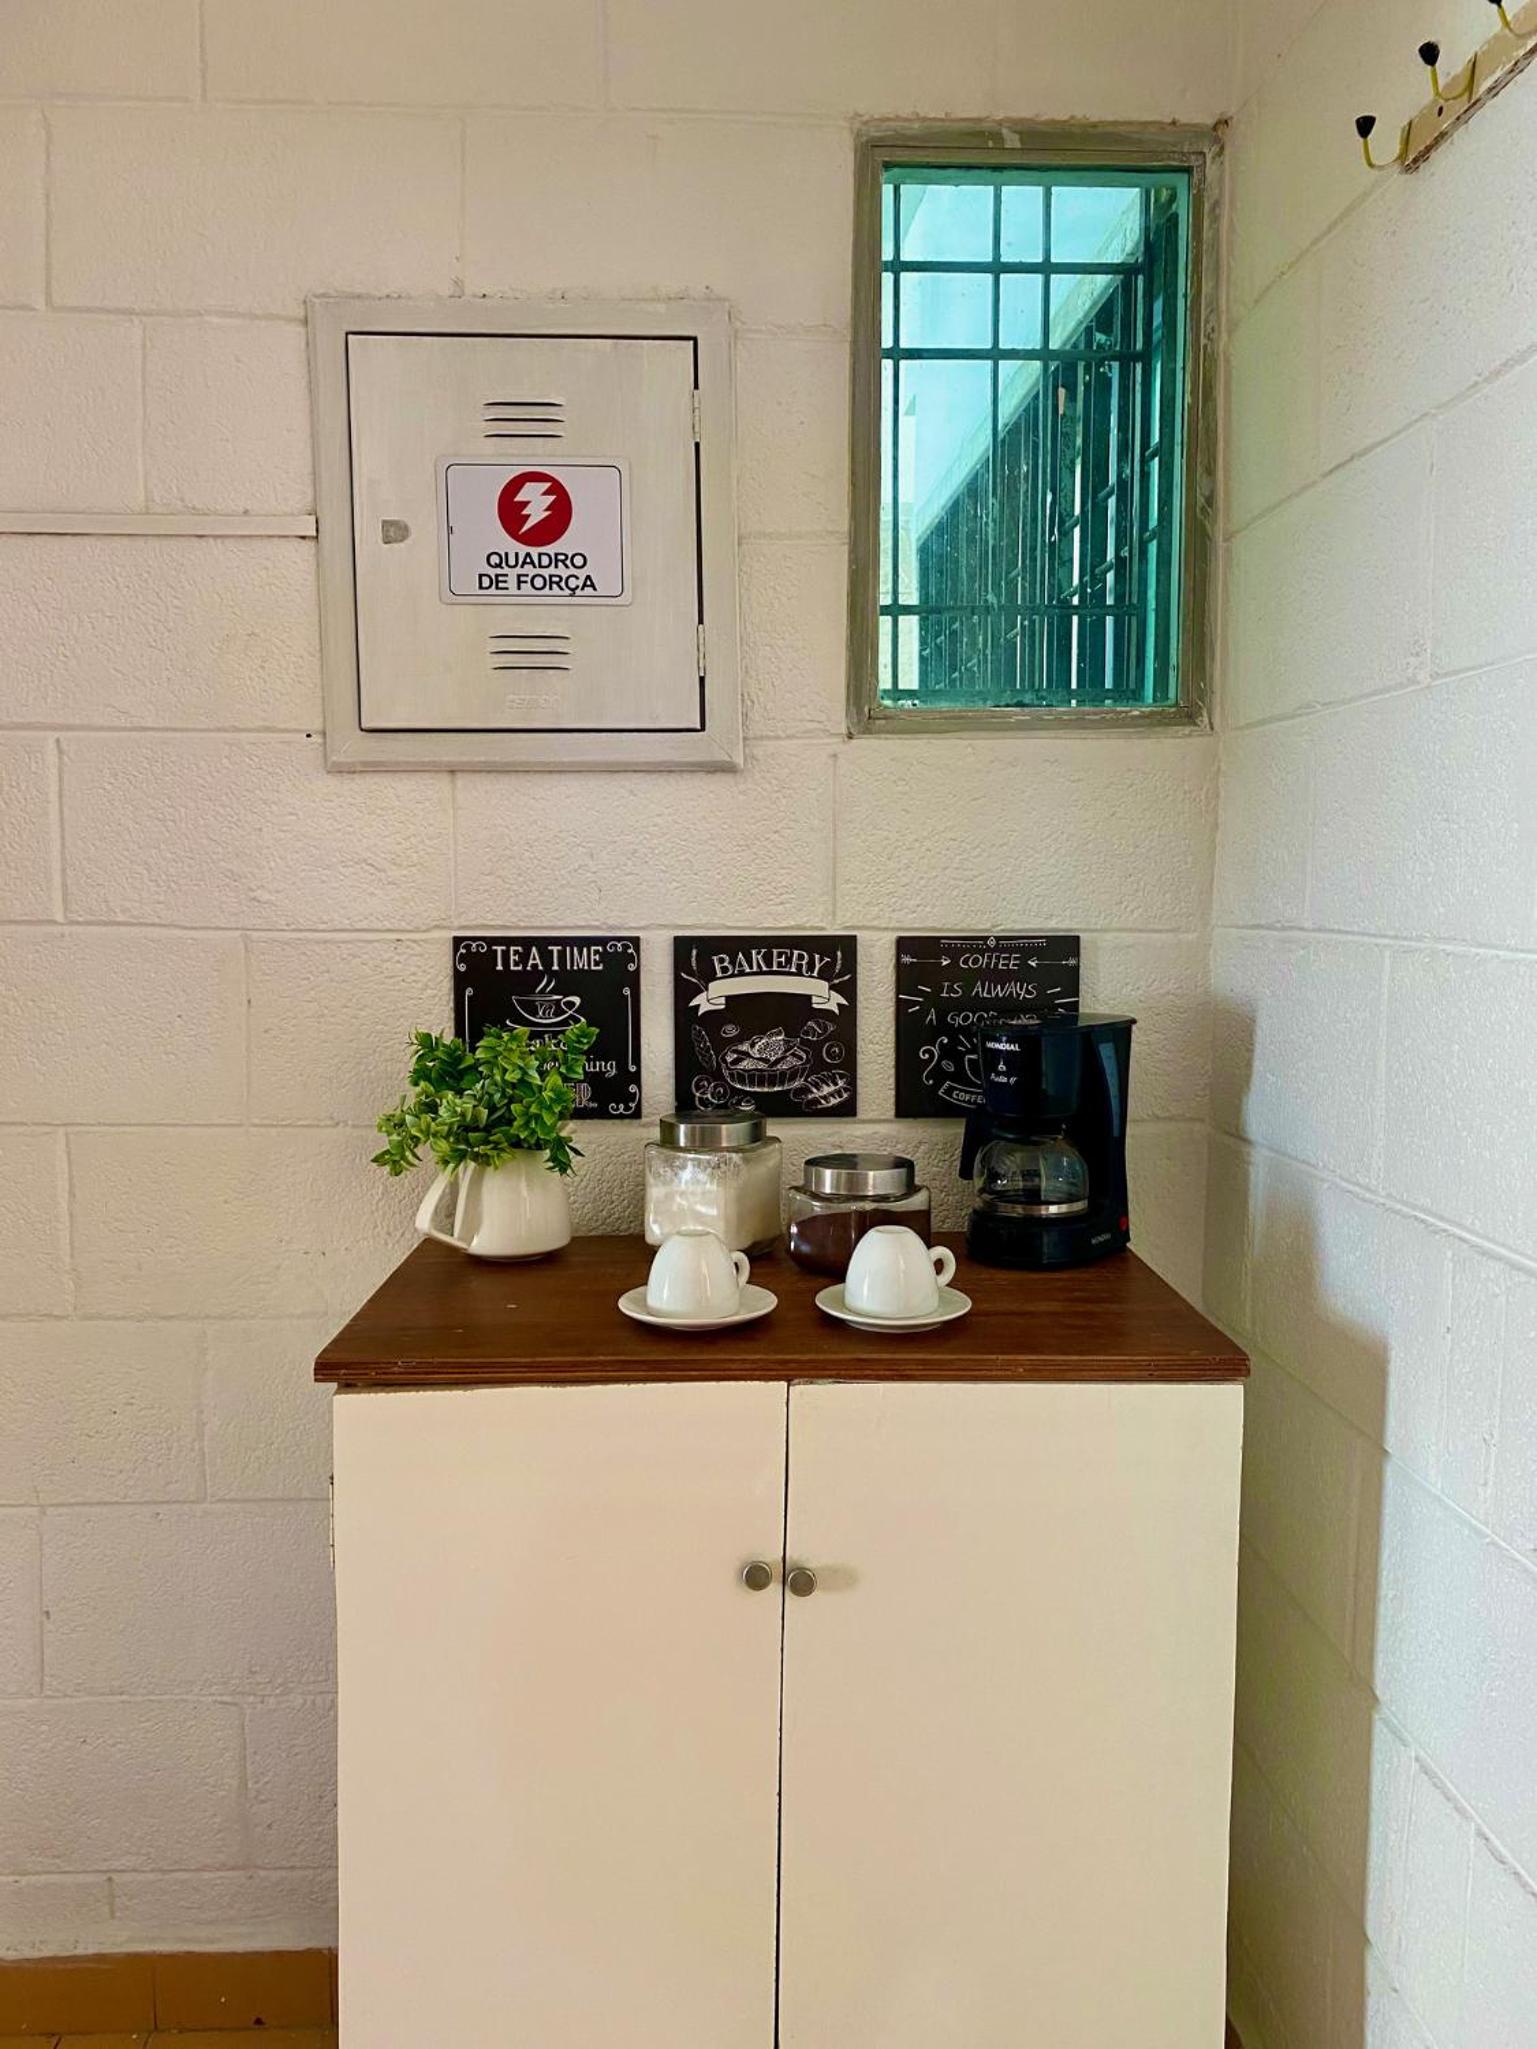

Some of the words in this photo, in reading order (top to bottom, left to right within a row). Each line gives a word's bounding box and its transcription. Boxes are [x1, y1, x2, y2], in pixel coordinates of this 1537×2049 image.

[486, 551, 588, 570] QUADRO
[478, 573, 509, 591] DE
[516, 574, 598, 597] FORÇA
[492, 946, 544, 971] TEA
[548, 946, 603, 971] TIME
[712, 948, 831, 978] BAKERY
[959, 953, 1021, 970] COFFEE
[940, 983, 963, 998] IS
[972, 982, 1038, 1000] ALWAYS
[925, 1007, 937, 1026] A
